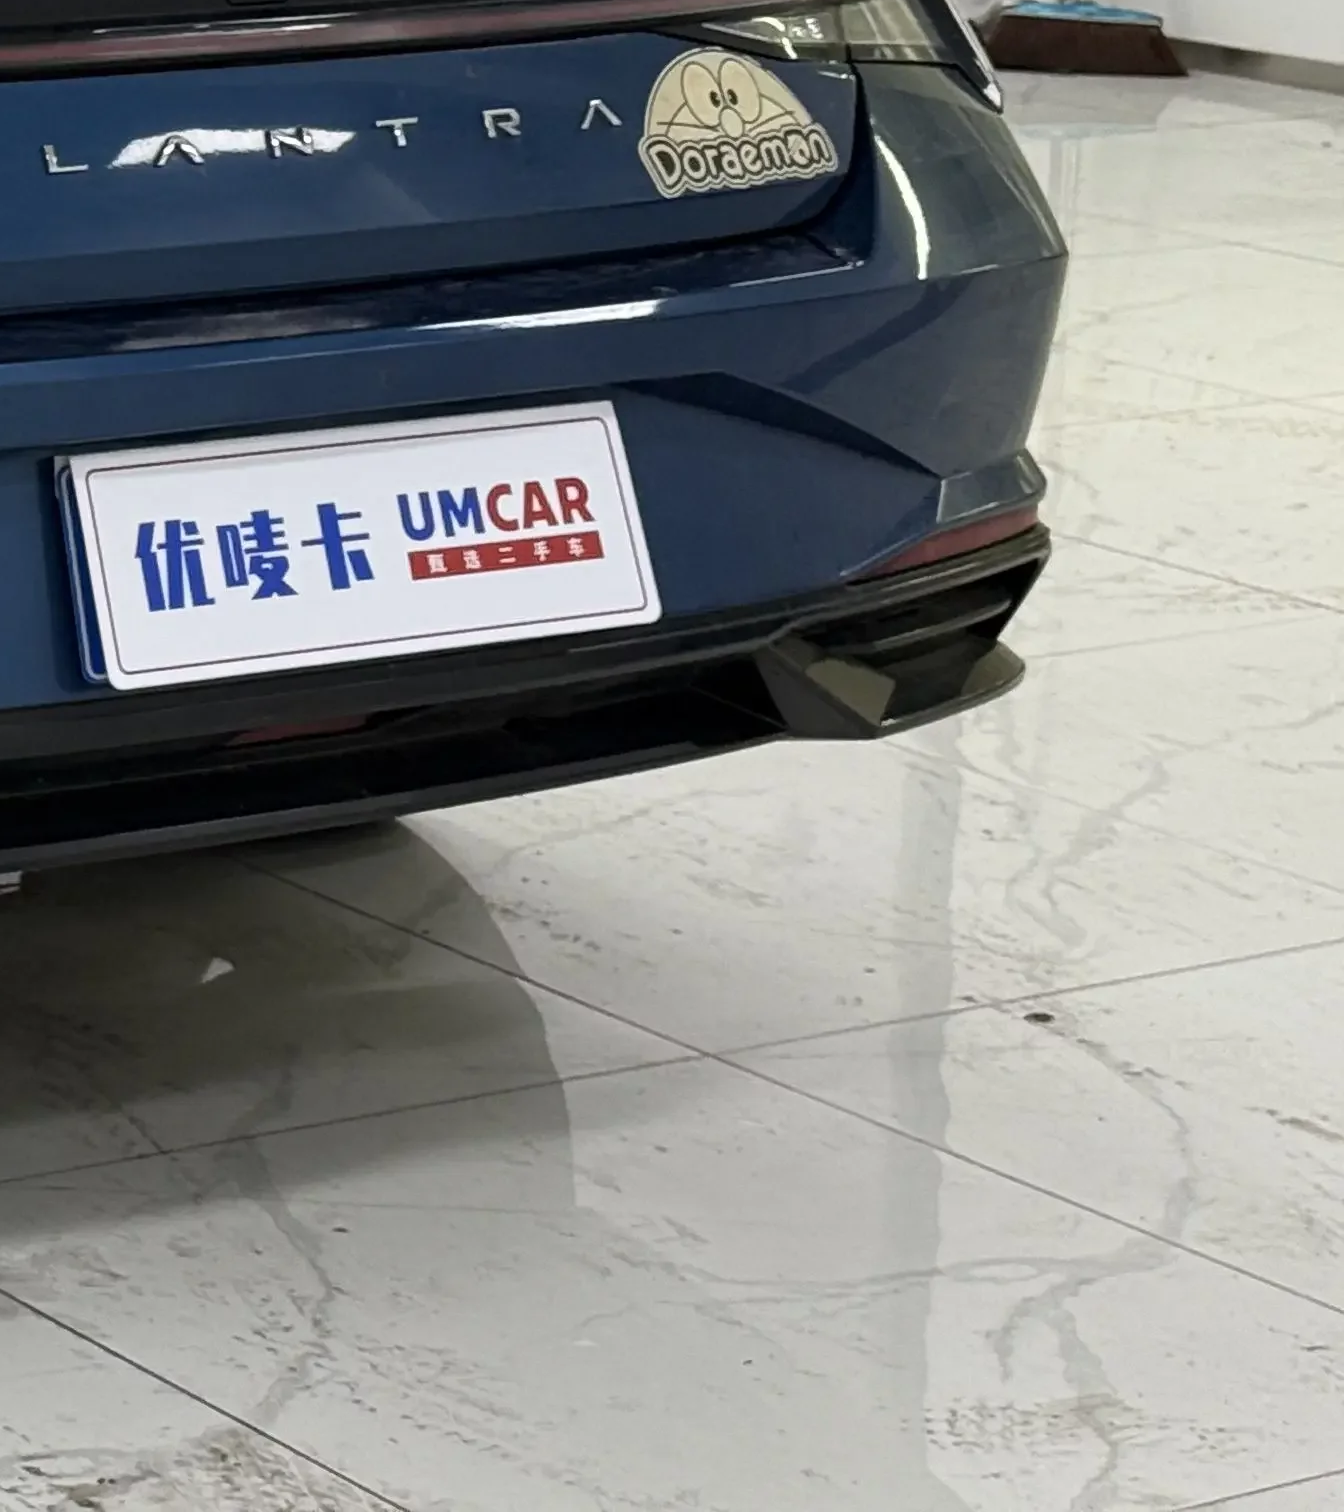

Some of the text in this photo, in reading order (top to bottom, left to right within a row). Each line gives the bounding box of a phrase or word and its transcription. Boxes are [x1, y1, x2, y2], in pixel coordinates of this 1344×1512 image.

[644, 129, 834, 190] Doraemon
[397, 477, 596, 541] UMCAR
[135, 502, 376, 612] 优唛卡
